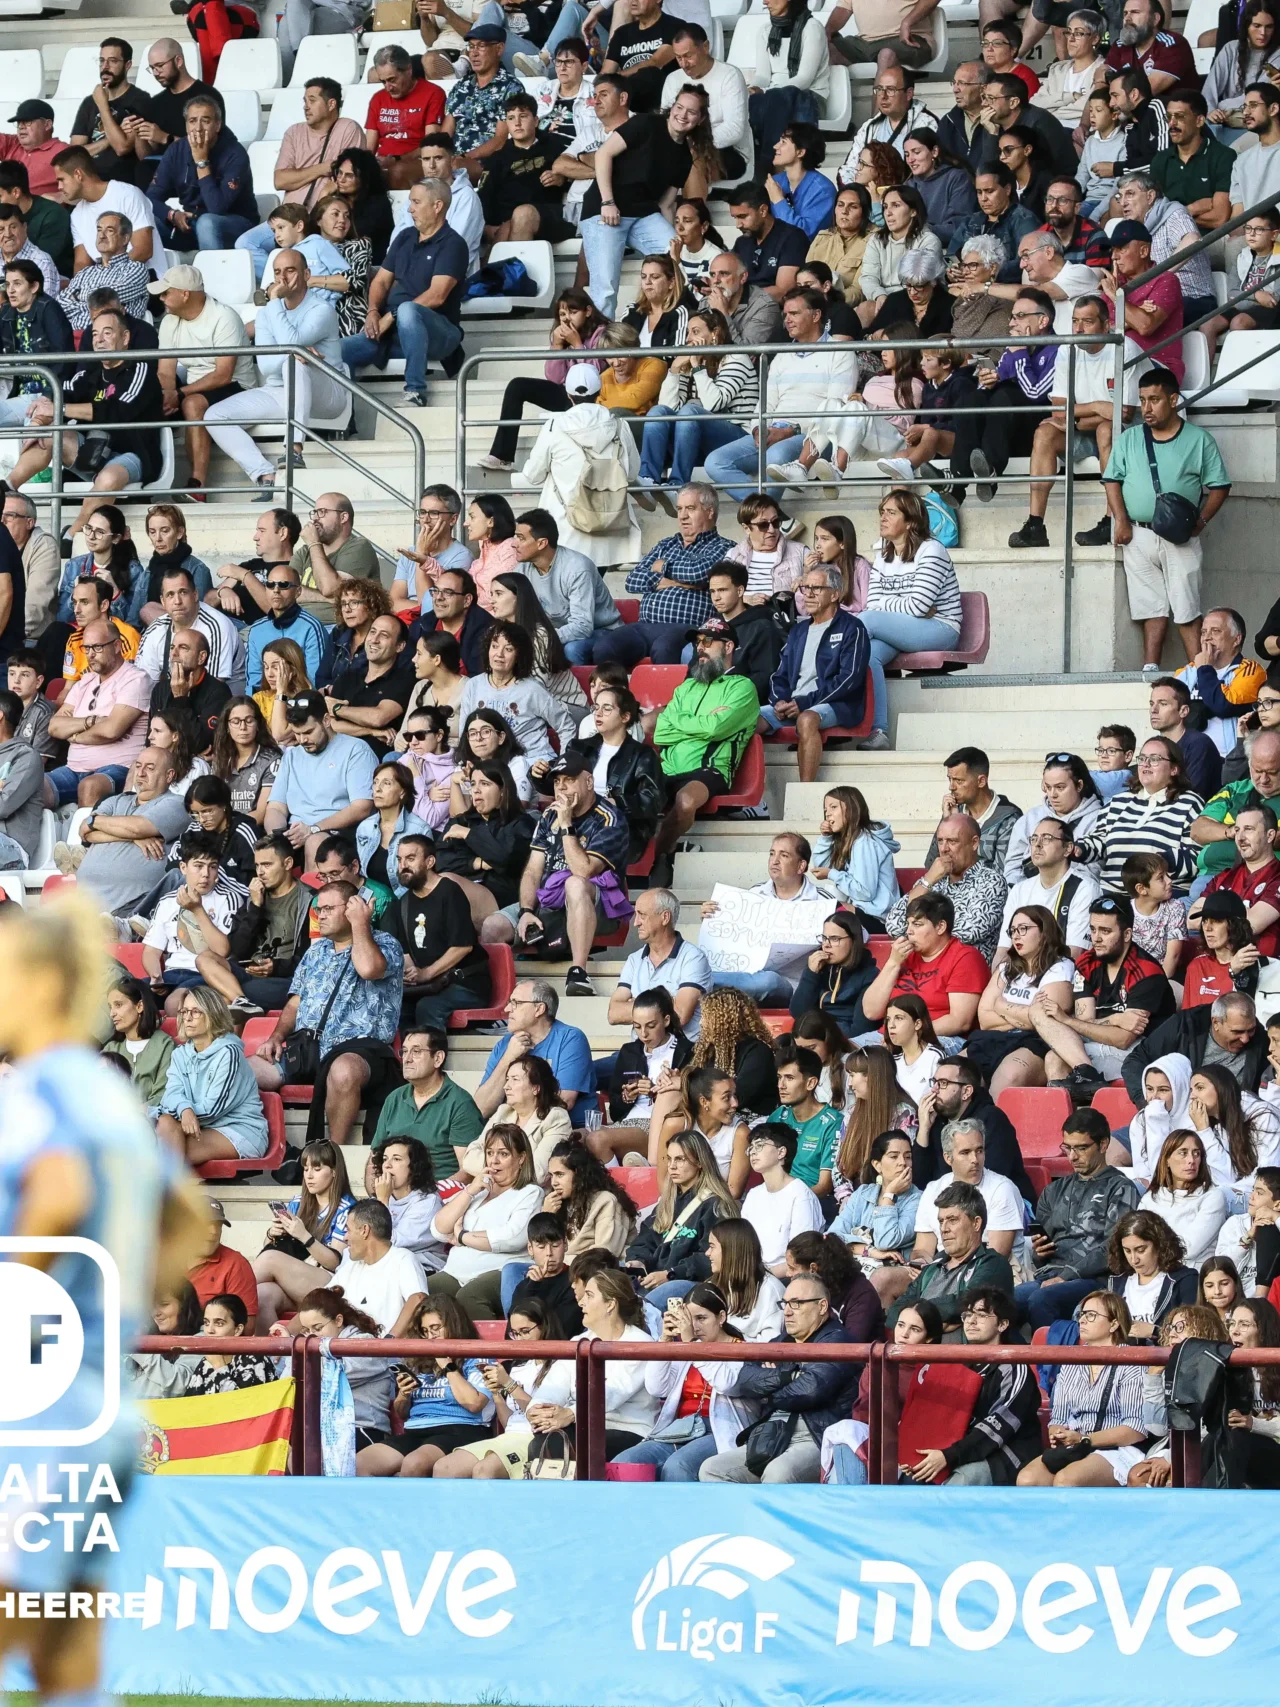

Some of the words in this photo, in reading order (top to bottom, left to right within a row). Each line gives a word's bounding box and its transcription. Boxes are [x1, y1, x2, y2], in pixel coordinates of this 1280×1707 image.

[620, 38, 663, 57] RAMONES
[1026, 44, 1043, 60] 21
[421, 1387, 445, 1399] BETTER
[142, 1545, 517, 1638] moeve
[836, 1560, 1242, 1657] moeve
[655, 1608, 744, 1663] Liga
[754, 1611, 780, 1653] F
